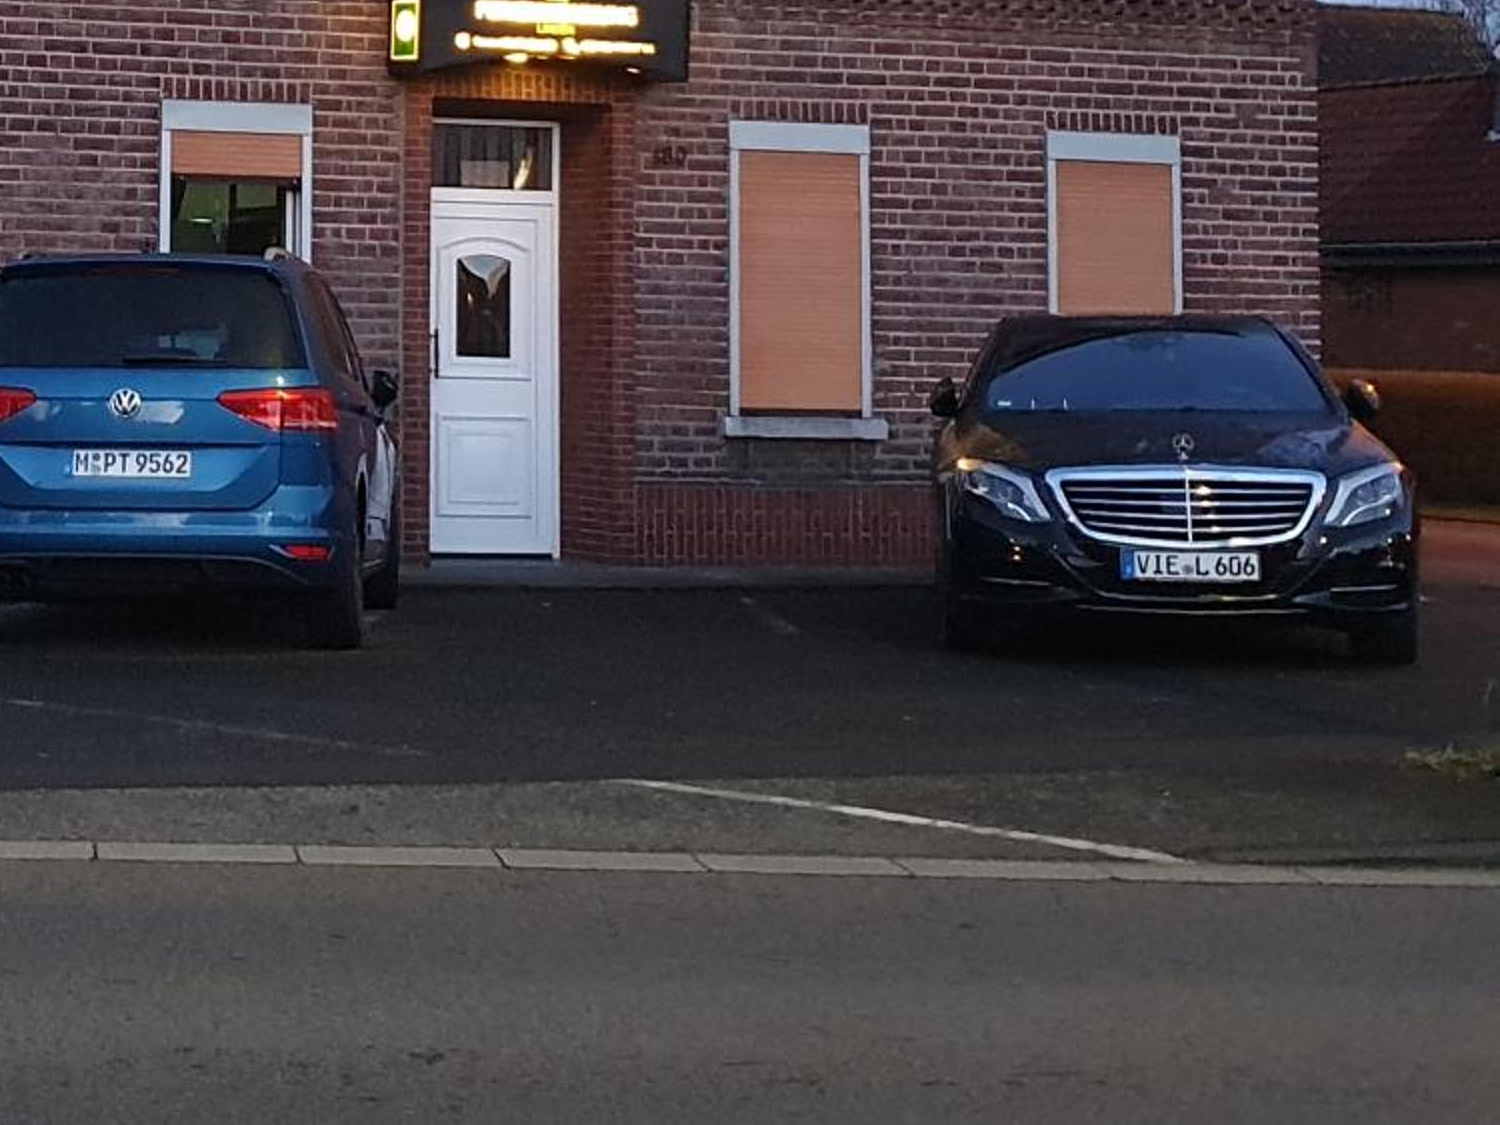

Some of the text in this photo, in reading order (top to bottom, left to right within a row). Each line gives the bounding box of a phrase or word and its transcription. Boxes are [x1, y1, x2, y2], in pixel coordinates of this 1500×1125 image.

[75, 452, 189, 474] M PT 9562
[1137, 554, 1256, 576] VIE L 606
